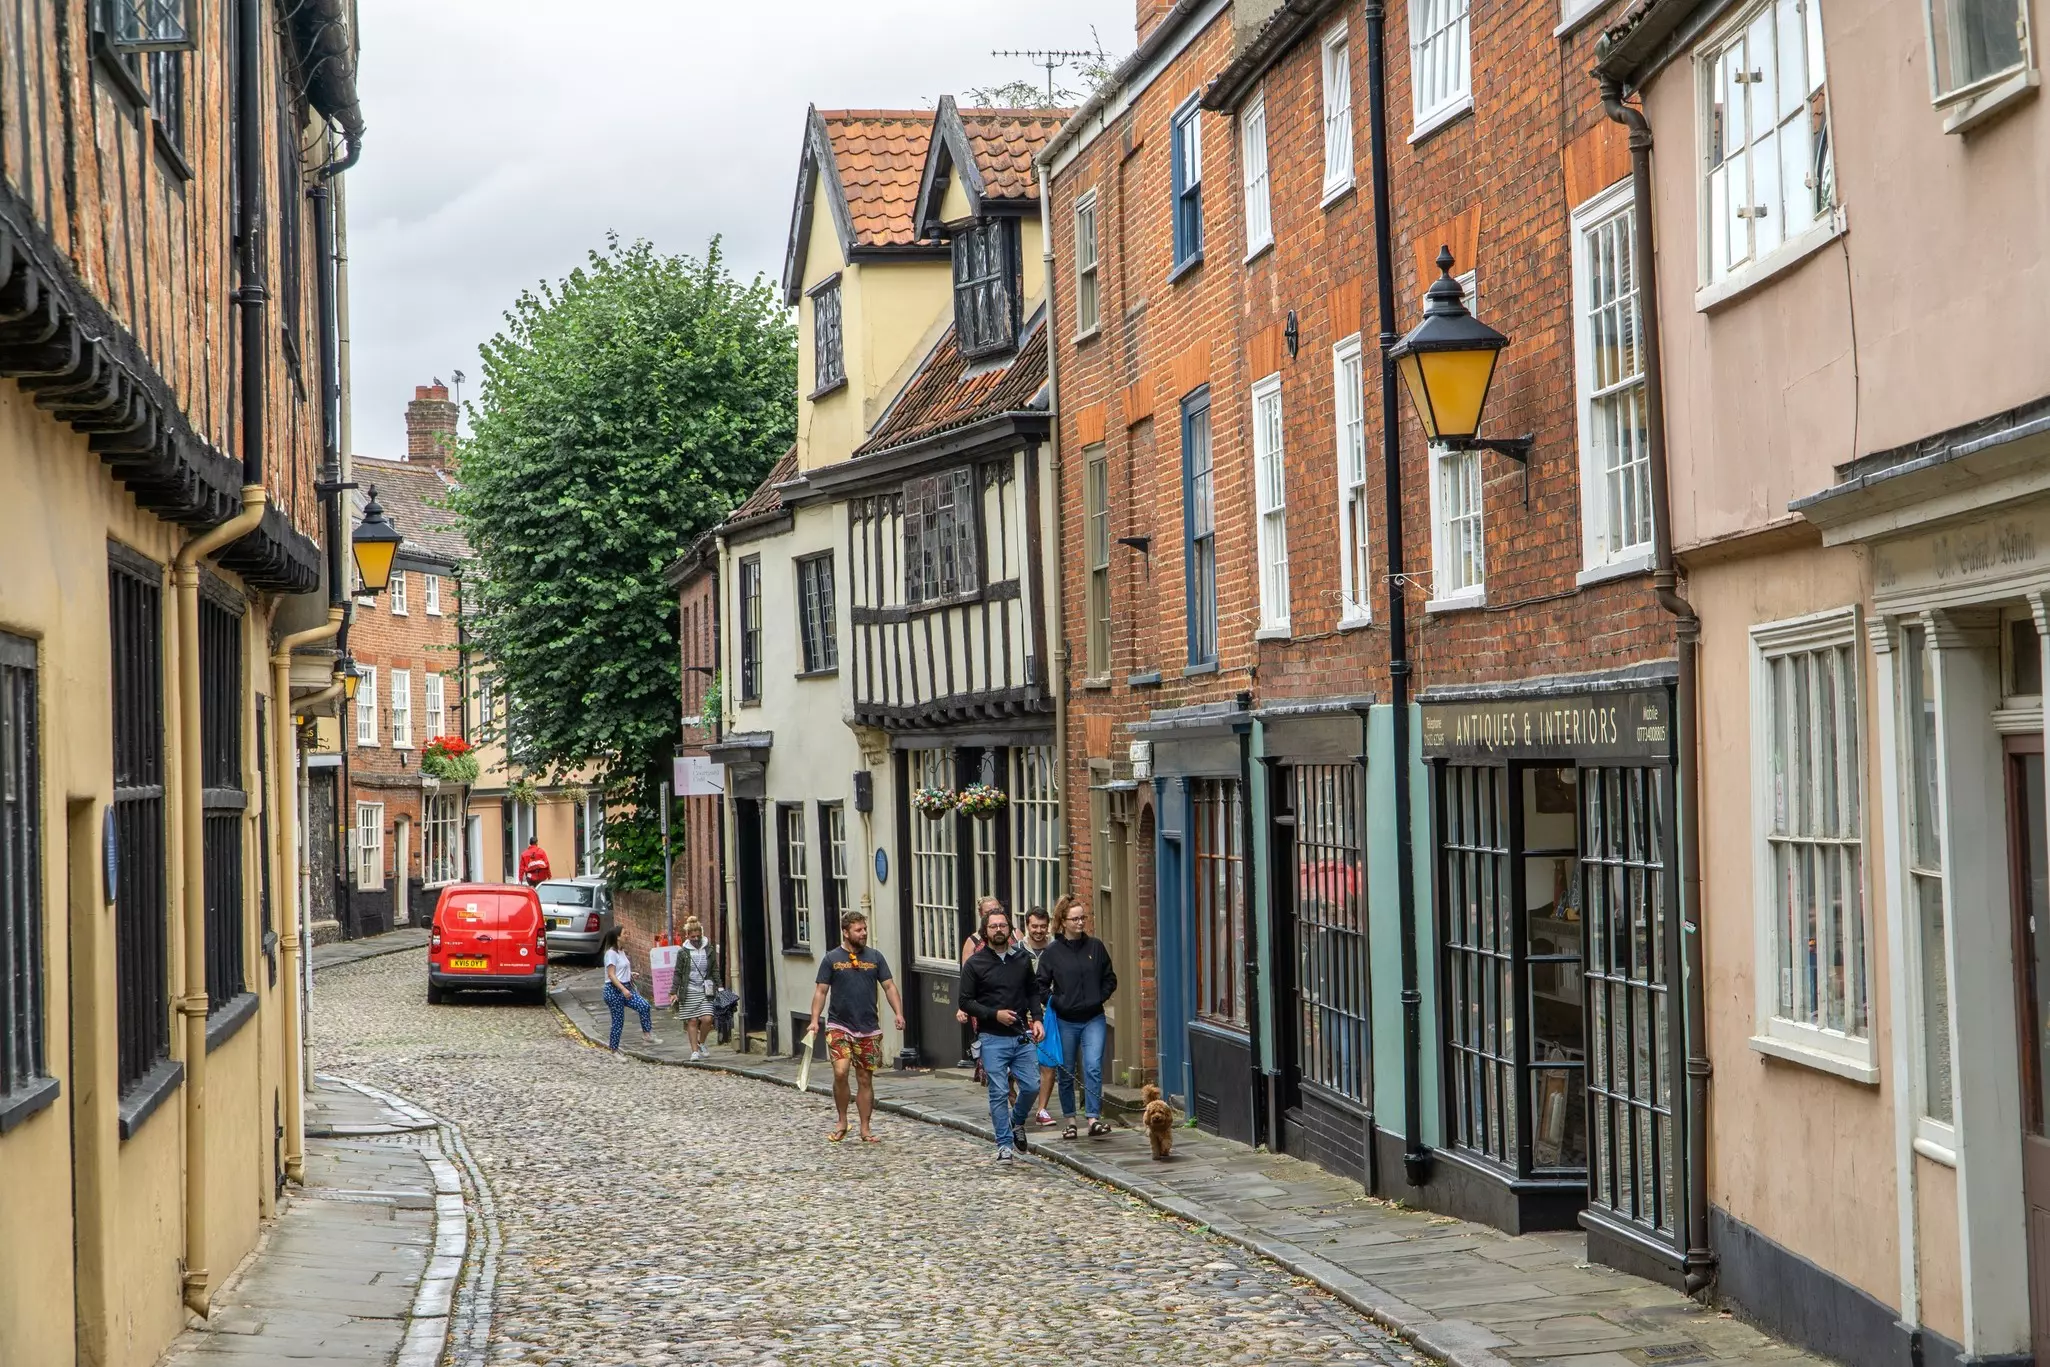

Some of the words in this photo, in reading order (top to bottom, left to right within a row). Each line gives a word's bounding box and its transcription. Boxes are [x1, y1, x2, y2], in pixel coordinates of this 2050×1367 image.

[1456, 713, 1515, 752] ANTIQUES
[1524, 712, 1532, 746] &
[1540, 706, 1617, 745] INTERIORS
